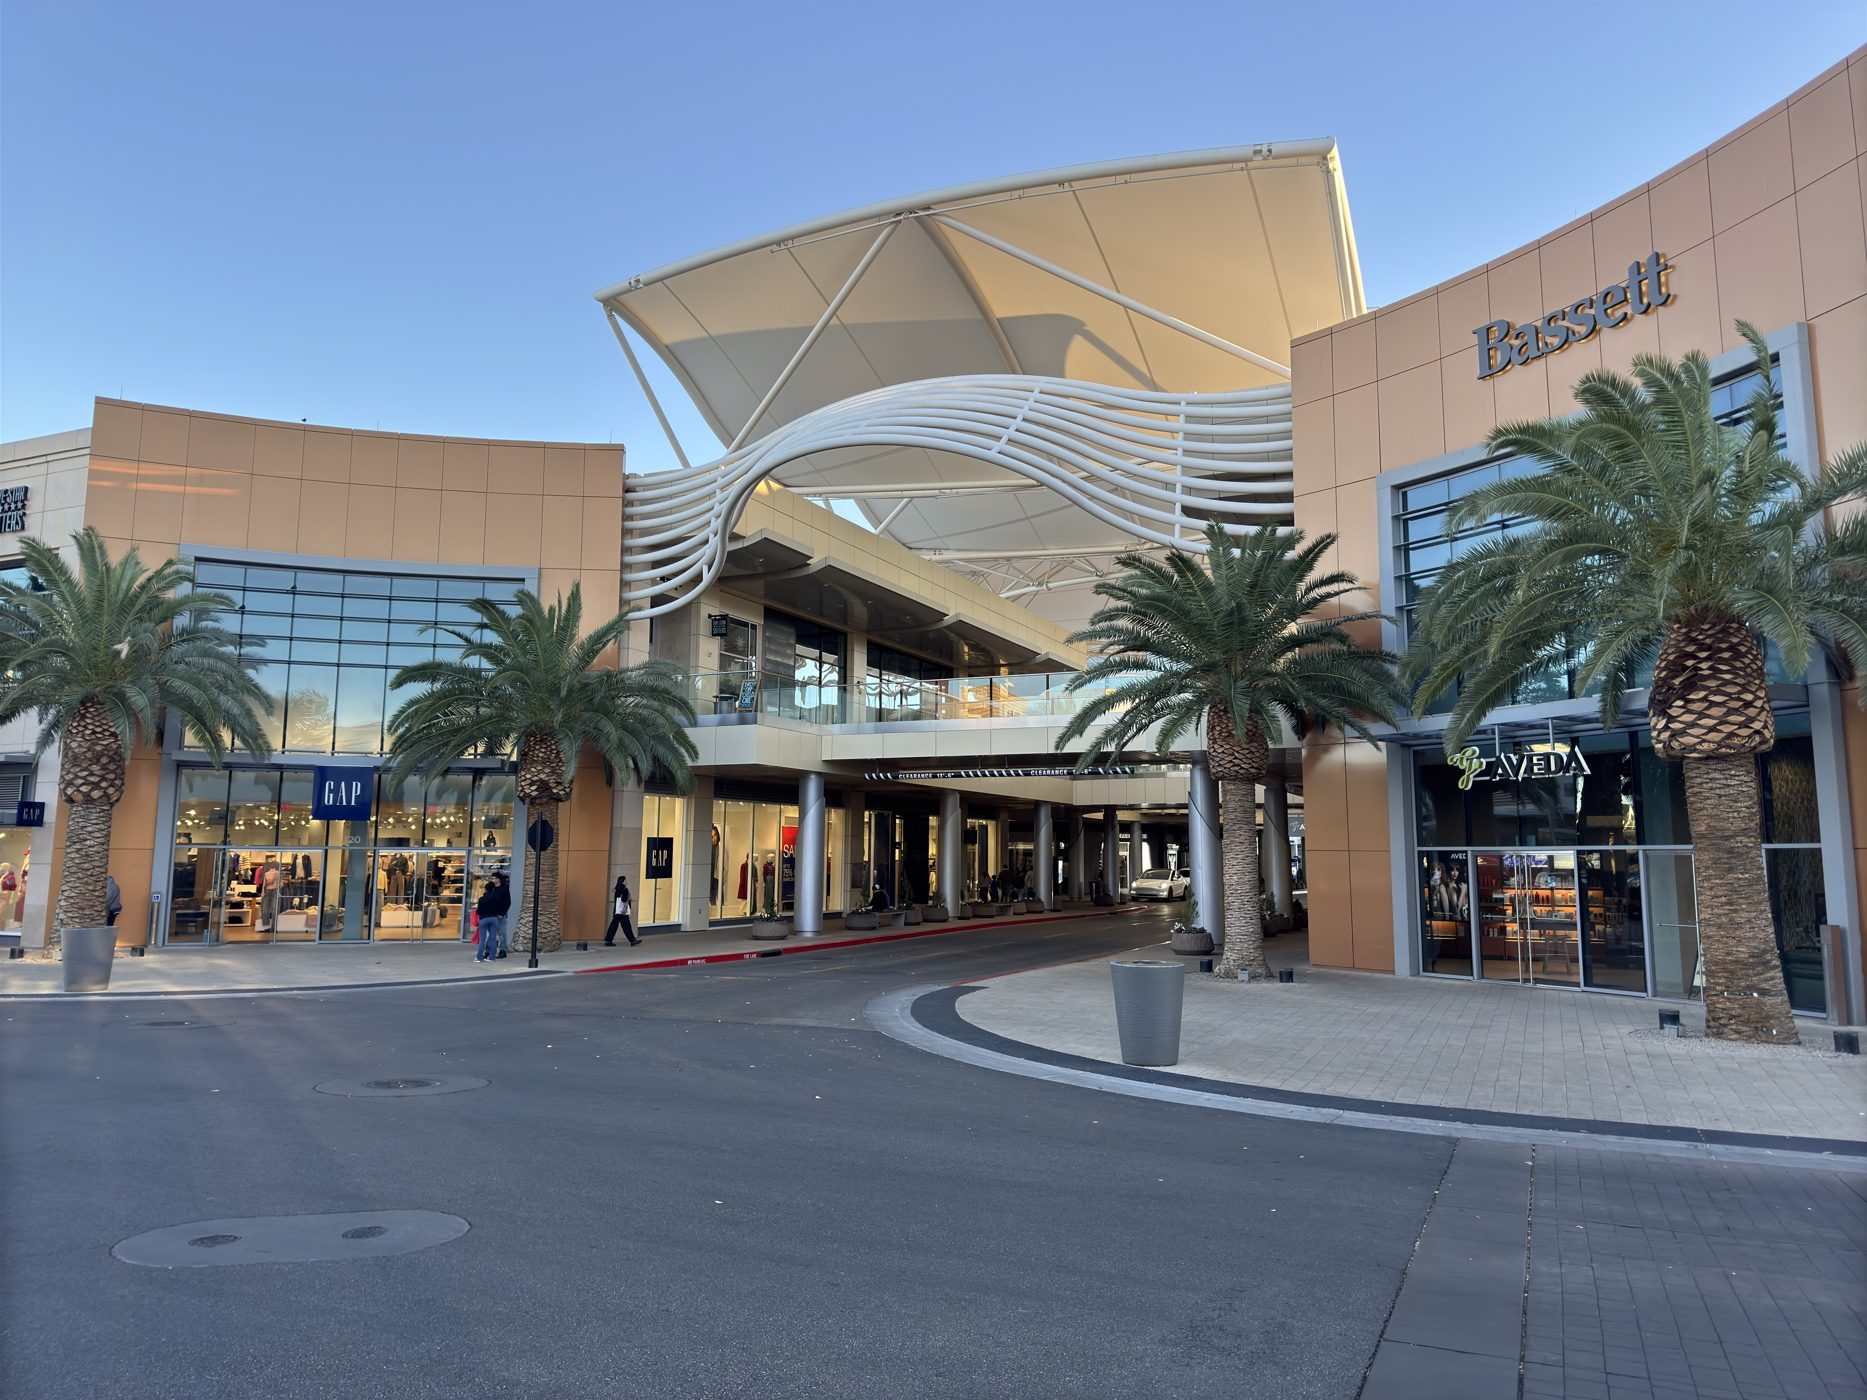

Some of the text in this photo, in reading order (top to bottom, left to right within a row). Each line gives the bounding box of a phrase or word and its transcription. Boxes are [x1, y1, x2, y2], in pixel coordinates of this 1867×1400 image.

[1472, 251, 1672, 380] Bassett
[0, 486, 25, 503] E-STAR
[0, 511, 23, 532] TERS
[1489, 746, 1591, 781] AVEDA
[324, 781, 361, 805] GAP
[22, 808, 40, 820] GAP
[652, 849, 668, 867] GAP
